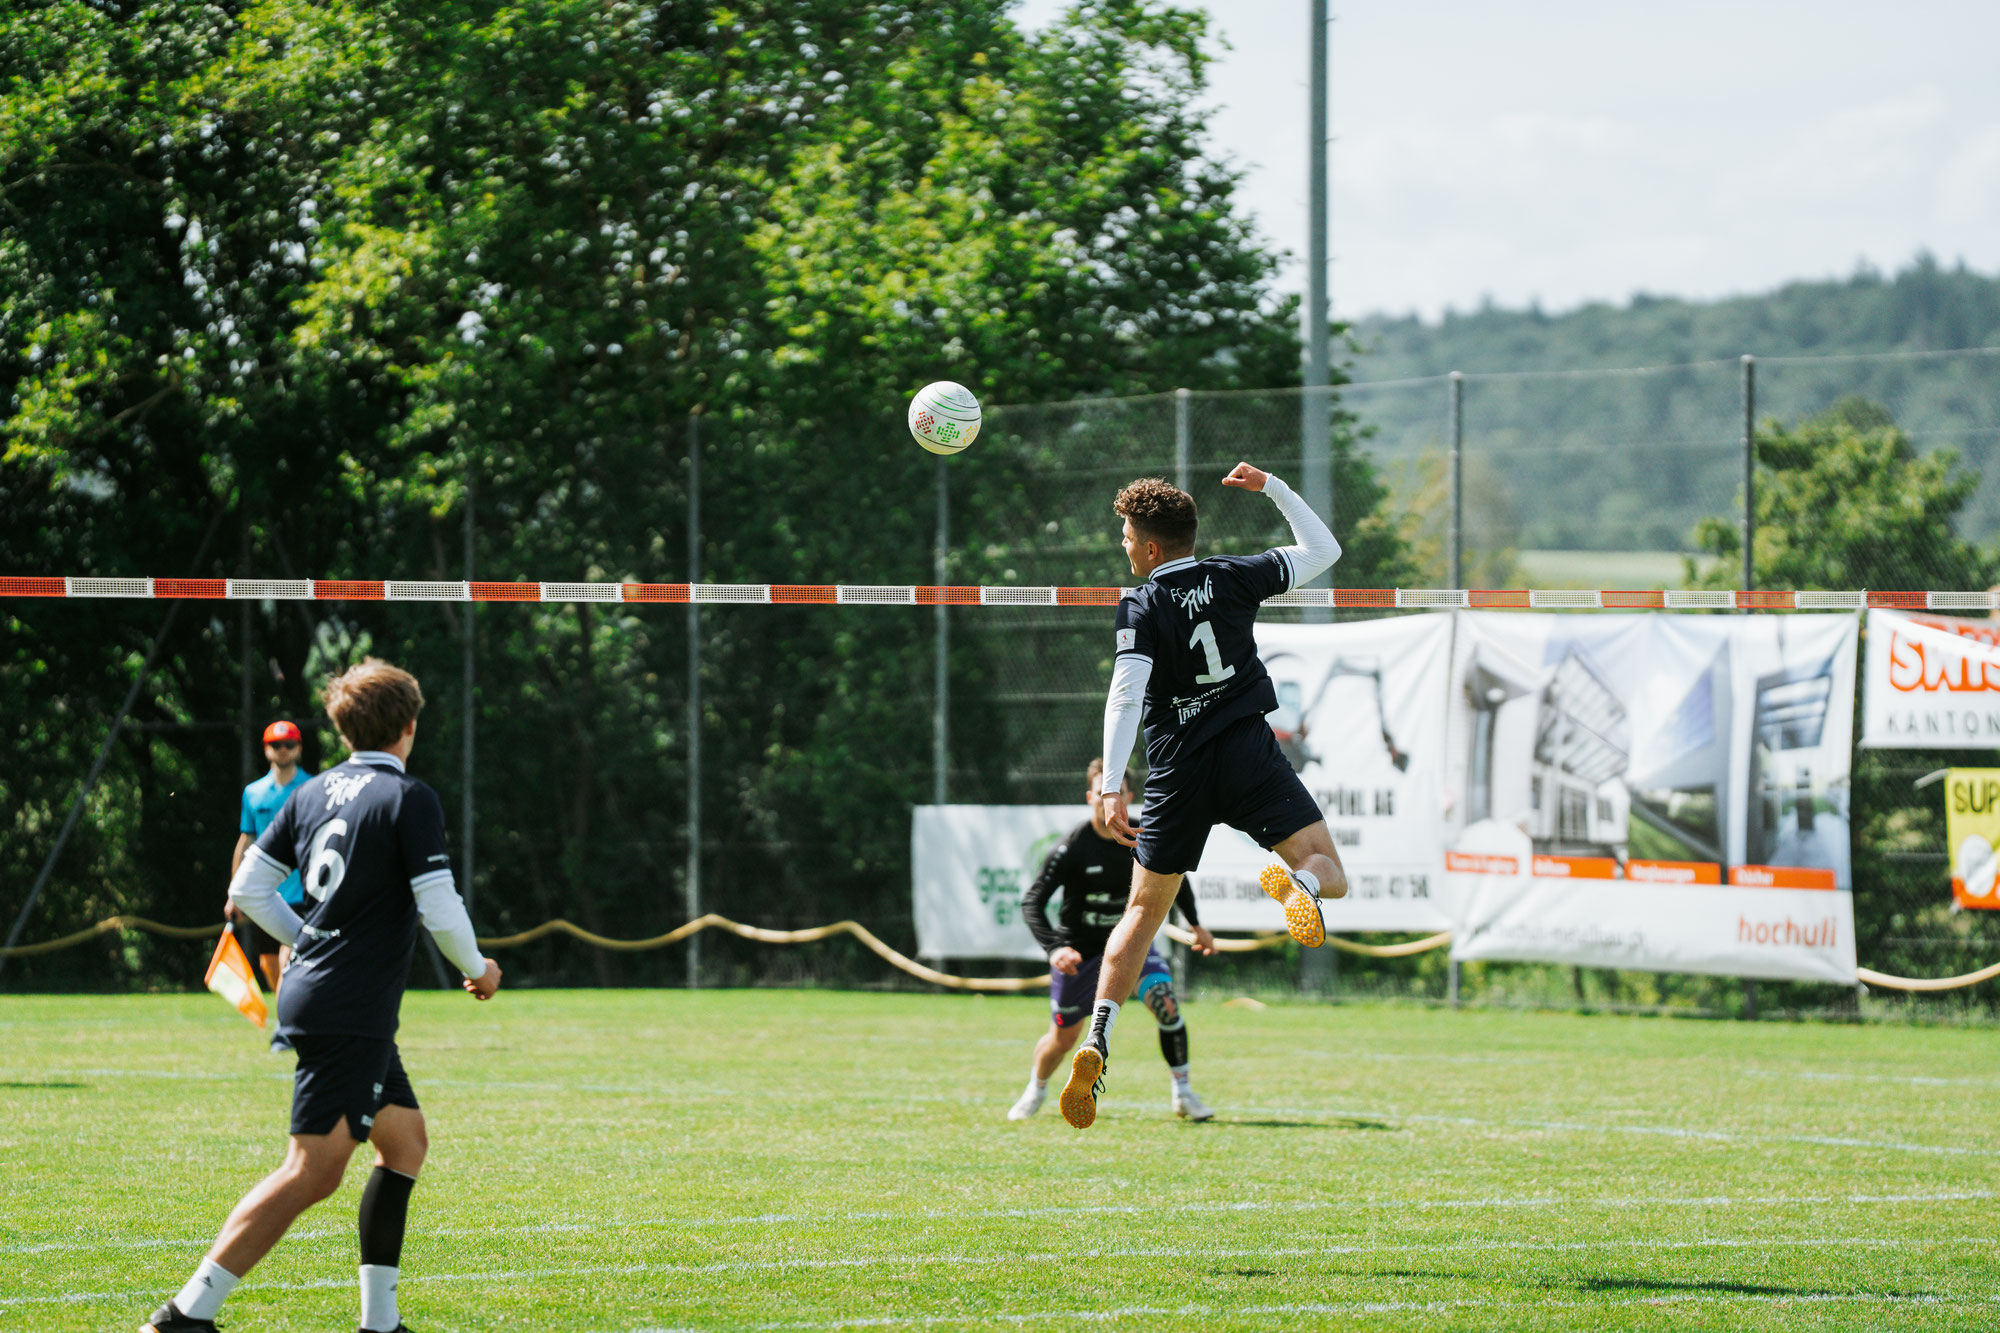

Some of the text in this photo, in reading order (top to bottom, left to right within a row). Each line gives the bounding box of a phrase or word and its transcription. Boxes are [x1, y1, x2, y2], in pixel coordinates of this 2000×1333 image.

[1189, 620, 1236, 685] 1
[1887, 710, 2000, 736] KANTON
[306, 818, 348, 903] 6
[1737, 914, 1837, 948] hochuli
